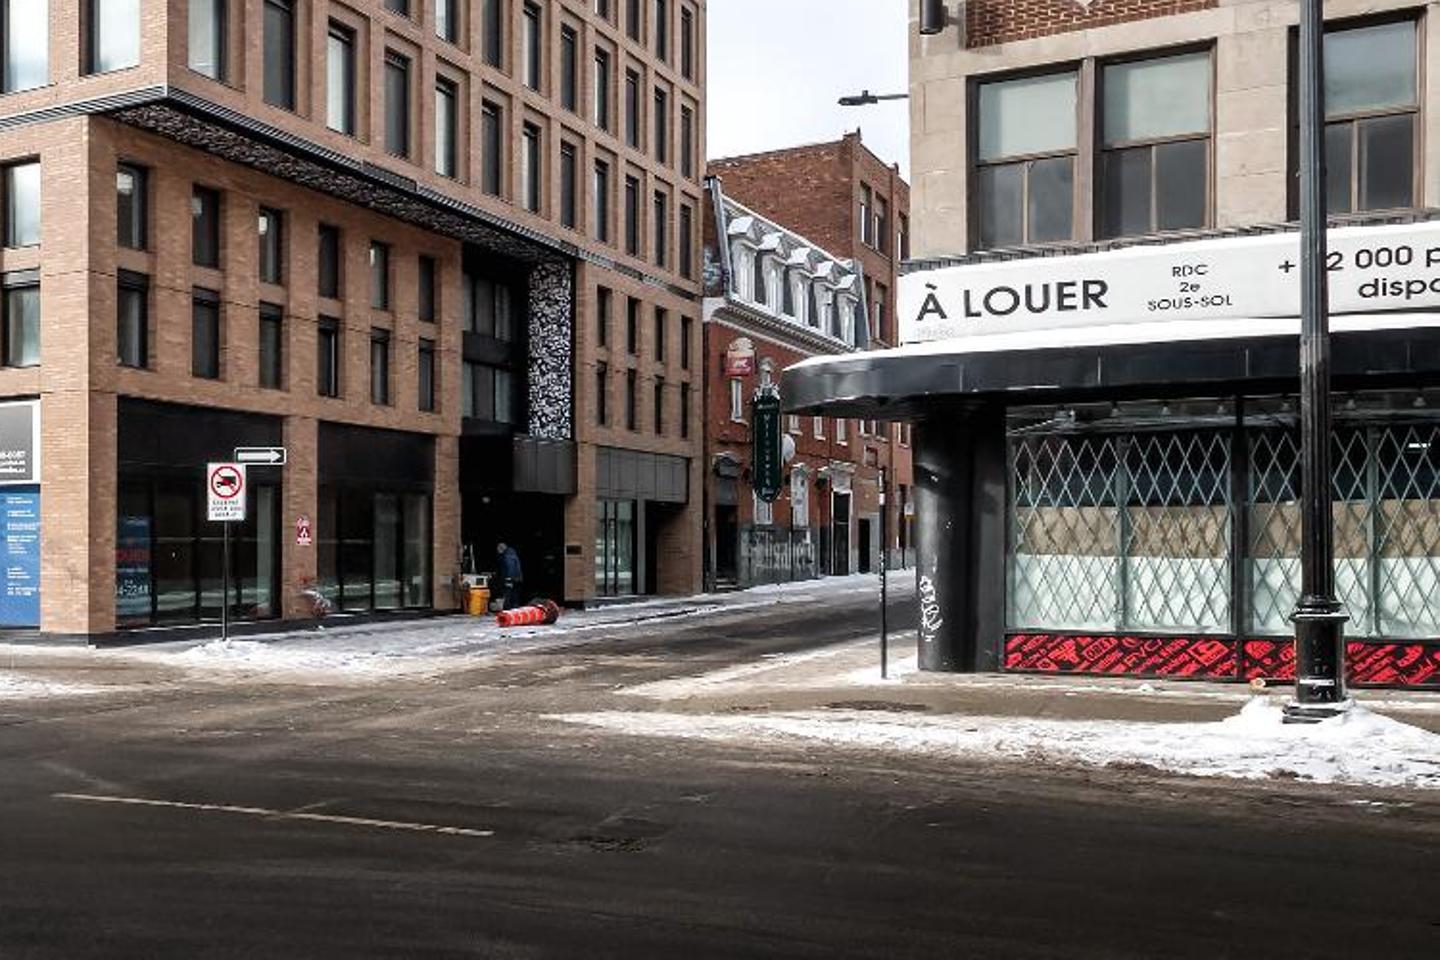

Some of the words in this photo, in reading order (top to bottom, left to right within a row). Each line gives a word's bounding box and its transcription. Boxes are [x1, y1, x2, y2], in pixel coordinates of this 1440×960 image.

[1355, 246, 1412, 269] 000
[1172, 264, 1208, 278] RDC
[916, 282, 948, 322] À
[963, 280, 1109, 318] LOUER
[1147, 295, 1233, 312] SOUS-SOL
